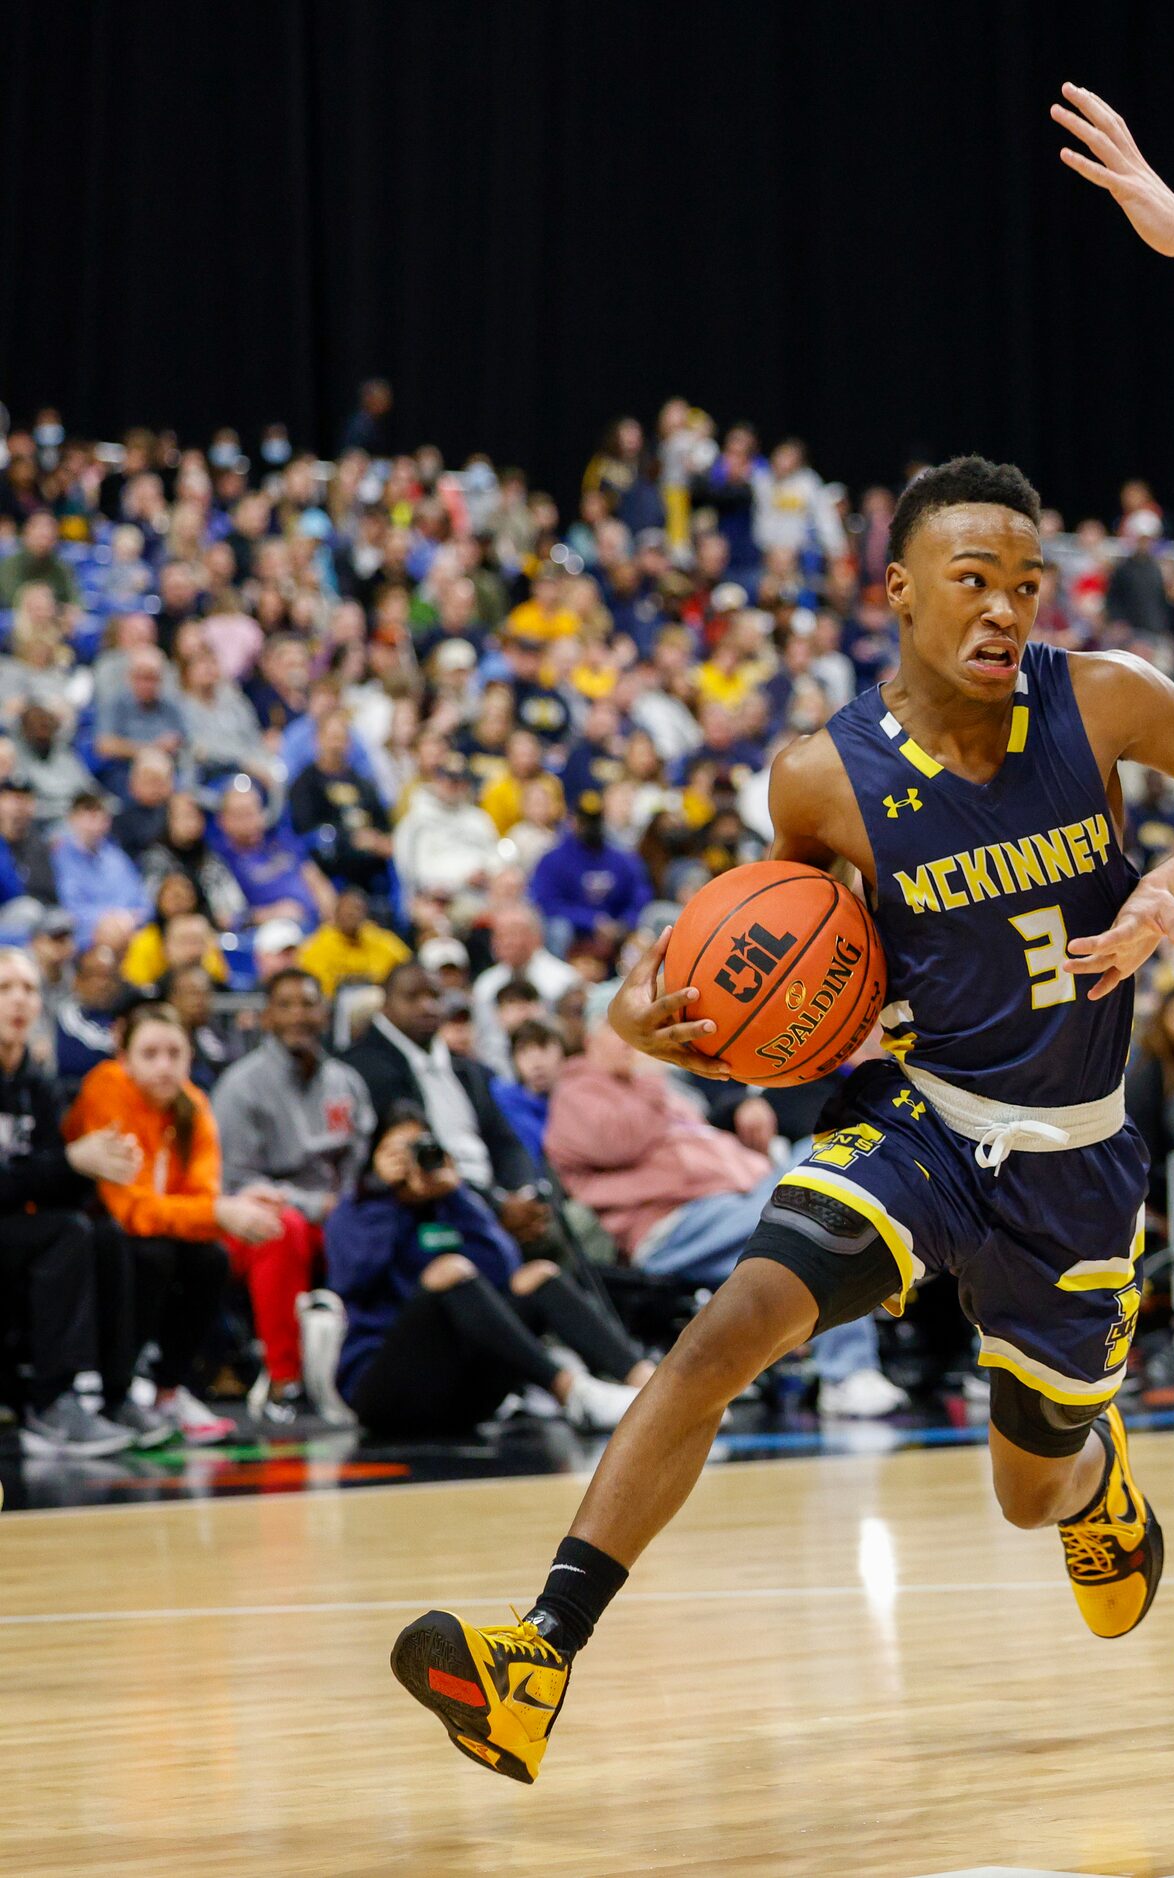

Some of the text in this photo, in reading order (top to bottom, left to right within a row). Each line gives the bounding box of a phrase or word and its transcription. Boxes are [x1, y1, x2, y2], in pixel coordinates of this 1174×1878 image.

[893, 813, 1109, 914] MCKINNEY
[755, 934, 863, 1068] SPALDING
[1008, 904, 1076, 1010] 3
